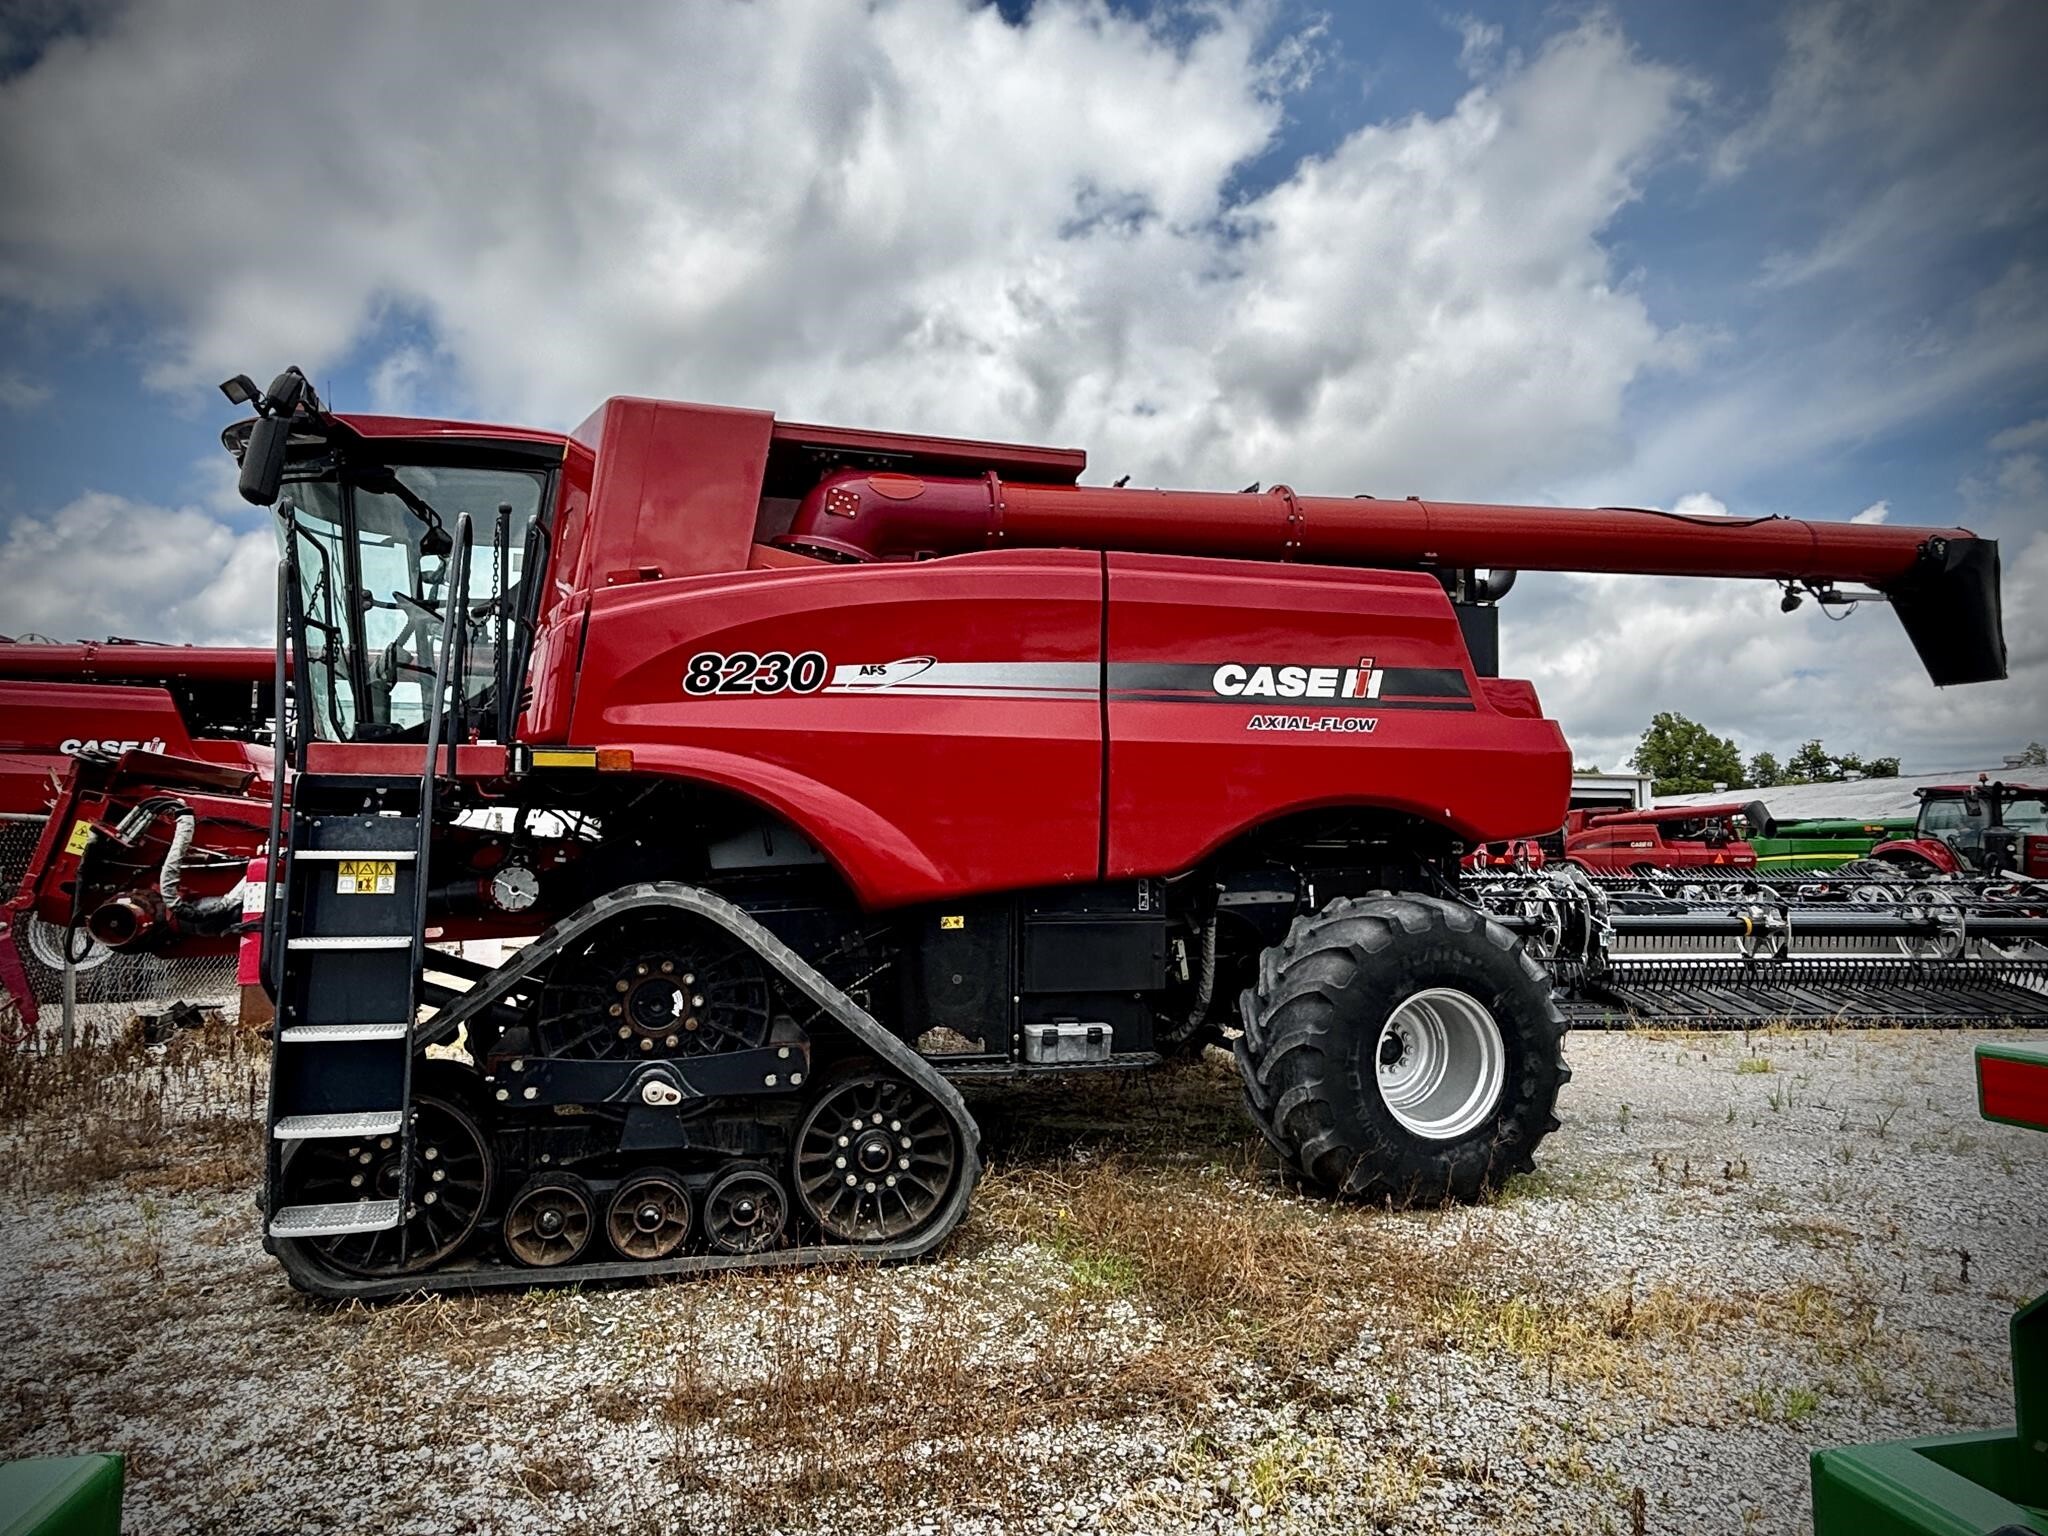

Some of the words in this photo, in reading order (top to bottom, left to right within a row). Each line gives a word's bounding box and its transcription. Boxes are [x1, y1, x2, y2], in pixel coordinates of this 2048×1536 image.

[683, 651, 828, 695] 8230
[858, 664, 887, 676] AFS
[1212, 664, 1339, 697] CASE
[1247, 714, 1378, 732] AXIAL-FLOW
